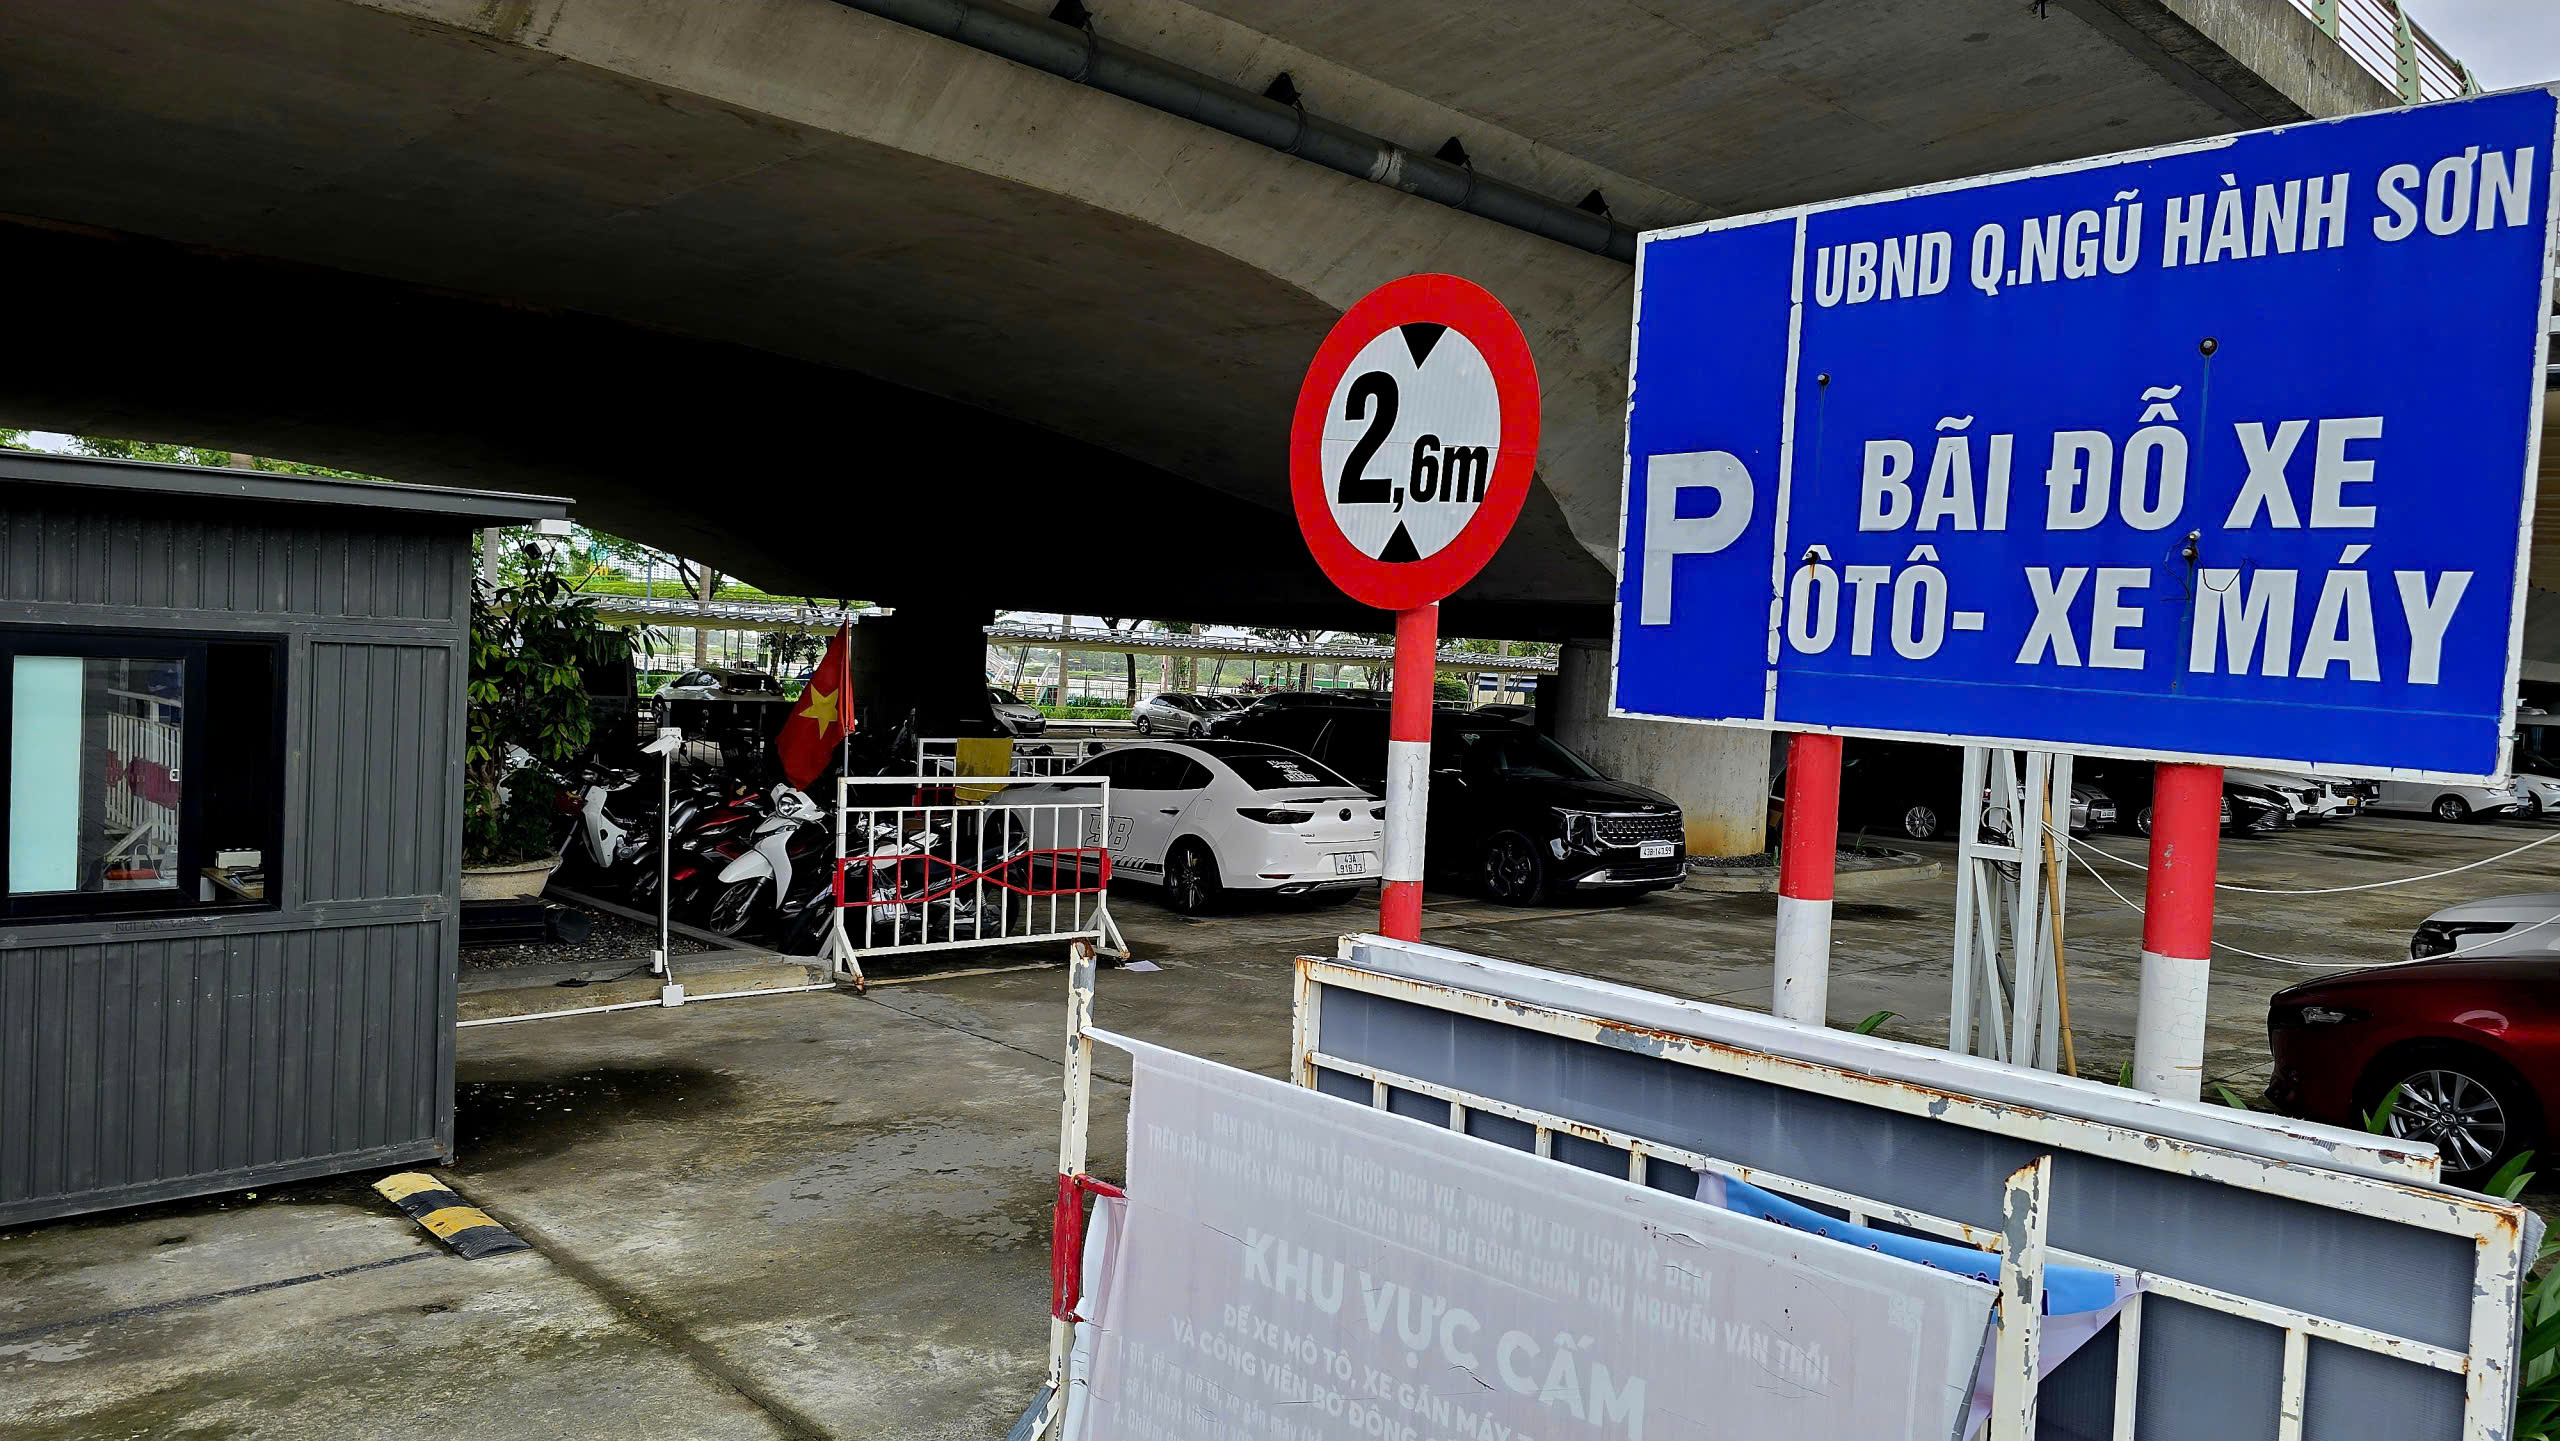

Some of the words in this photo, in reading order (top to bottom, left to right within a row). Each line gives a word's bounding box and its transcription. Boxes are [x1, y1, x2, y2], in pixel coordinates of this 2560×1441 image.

[1814, 231, 1952, 308] UBND
[1970, 189, 2143, 298] Q.NGŨ
[2162, 172, 2350, 269] HÀNH
[2372, 146, 2536, 243] SƠN
[1337, 370, 1490, 514] 2,6m
[1857, 415, 2014, 533] BÃI
[2045, 384, 2190, 533] ĐỖ
[2223, 417, 2385, 530] XE
[1639, 450, 1756, 627] P
[2014, 566, 2154, 671] XE
[2188, 544, 2475, 685] MÁY
[1212, 1111, 1239, 1142] BAN
[1278, 1130, 1316, 1169] HÀNH
[1343, 1153, 1385, 1187] CHỨC
[1390, 1168, 1428, 1206] DỊCH
[1466, 1194, 1514, 1234] PHỤC
[1550, 1221, 1576, 1254] DU
[1583, 1231, 1626, 1273] LỊCH
[1356, 1196, 1399, 1233] CÔNG
[1172, 1315, 1196, 1348] VÀ
[1199, 1330, 1257, 1377] CÔNG
[1260, 1358, 1308, 1402] VIÊN
[1312, 1384, 1347, 1418] BỜ
[1244, 1227, 1346, 1315] KHU
[1359, 1269, 1482, 1370] VỰC
[1496, 1329, 1648, 1441] CẤM
[1252, 1315, 1280, 1350] XE
[1282, 1330, 1319, 1365] MÔ
[1322, 1347, 1357, 1389] TÔ,
[1362, 1364, 1393, 1401] XE
[1398, 1382, 1450, 1428] GẮN
[1455, 1405, 1511, 1441] MÁY
